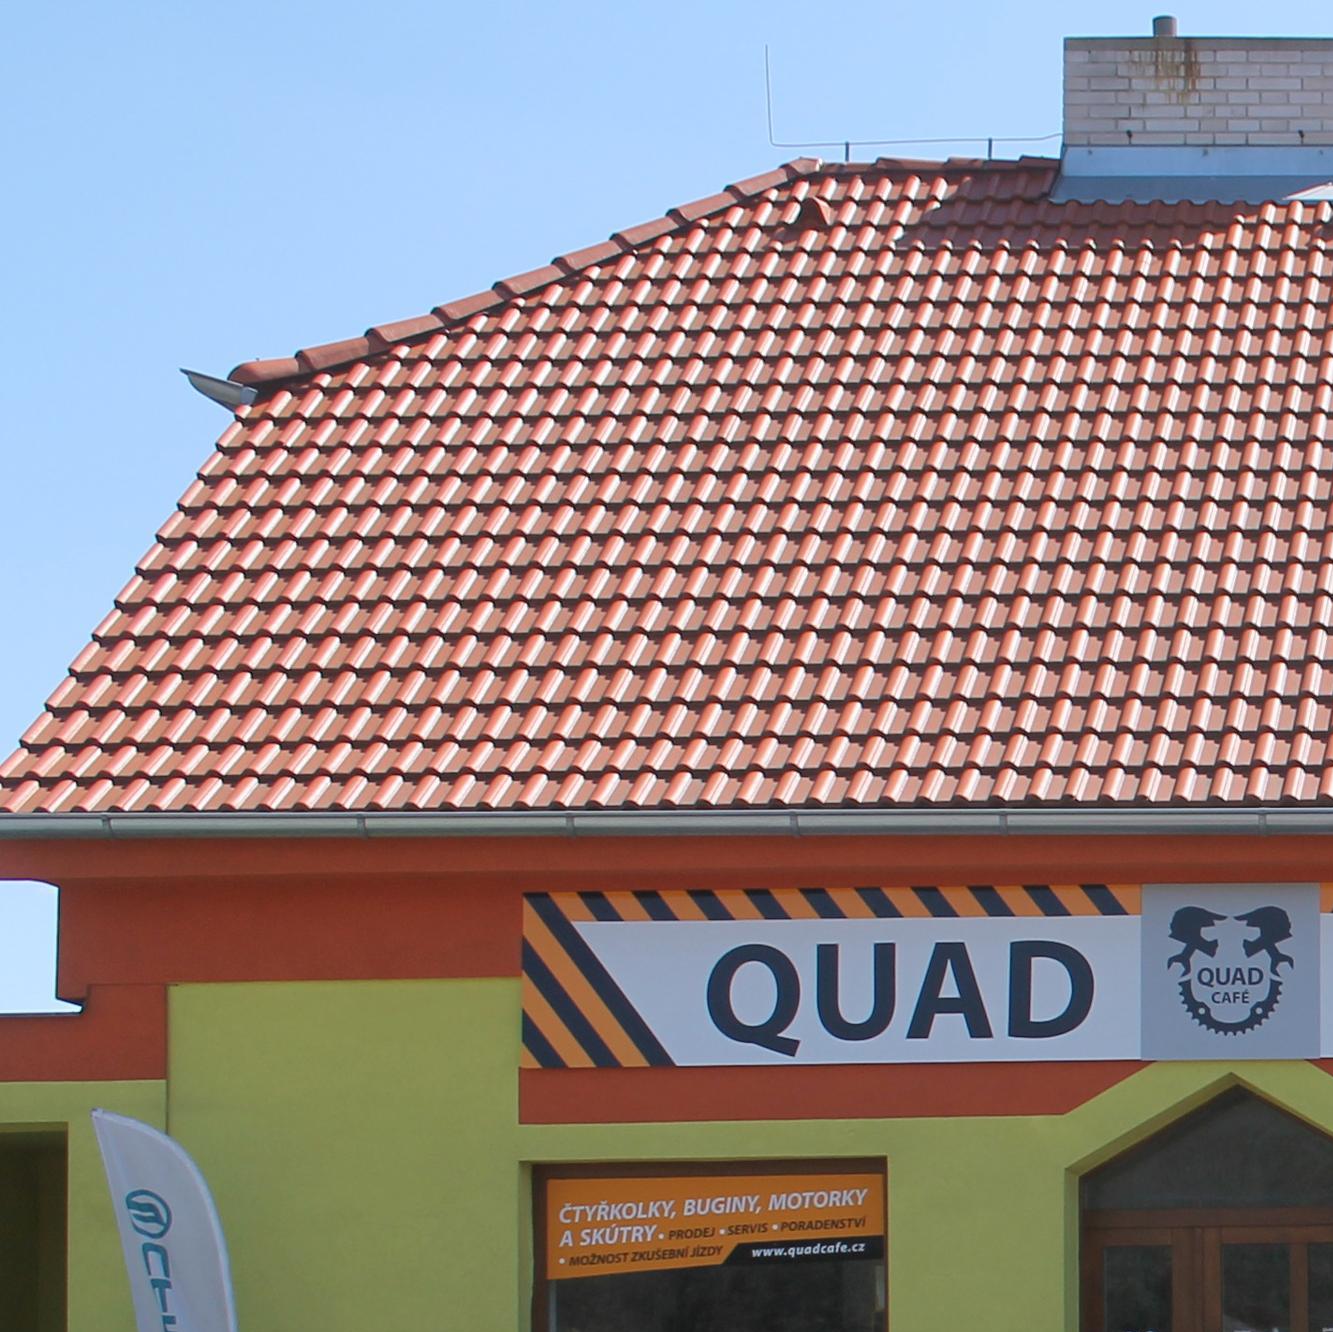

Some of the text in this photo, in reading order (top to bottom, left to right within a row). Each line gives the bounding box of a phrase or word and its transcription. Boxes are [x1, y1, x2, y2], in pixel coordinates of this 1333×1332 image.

[1197, 967, 1264, 988] QUAD
[706, 939, 1095, 1058] QUAD
[1211, 989, 1250, 1004] CAFÉ
[559, 1188, 868, 1223] ČTYŘKOLKY, BUGINY, MOTORKY
[559, 1215, 867, 1247] A SKÚTRY PRODEJ SERVIS PORADENSTVÍ
[568, 1251, 629, 1267] MOŽNOST
[631, 1245, 690, 1263] ZKUŠEBNÍ
[751, 1241, 866, 1259] www.quadcafe.cz
